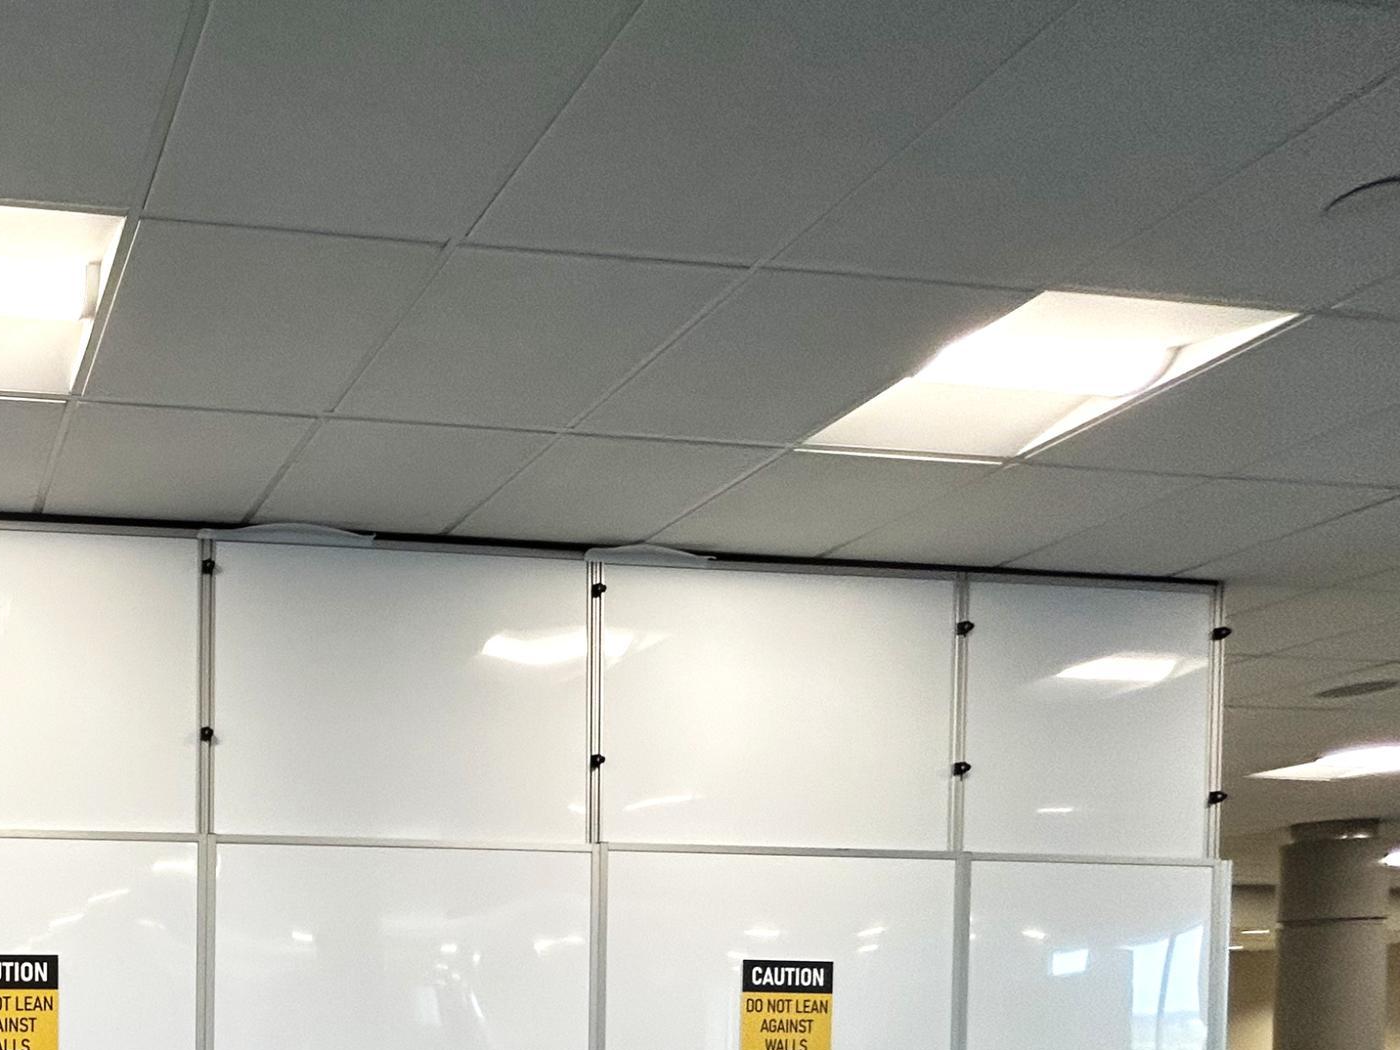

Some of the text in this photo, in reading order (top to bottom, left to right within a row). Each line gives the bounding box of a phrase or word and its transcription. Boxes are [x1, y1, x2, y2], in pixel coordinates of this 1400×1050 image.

[752, 966, 824, 987] CAUTION
[15, 996, 53, 1011] LEAN
[746, 998, 828, 1014] DO NOT LEAN
[760, 1018, 814, 1034] AGAINST
